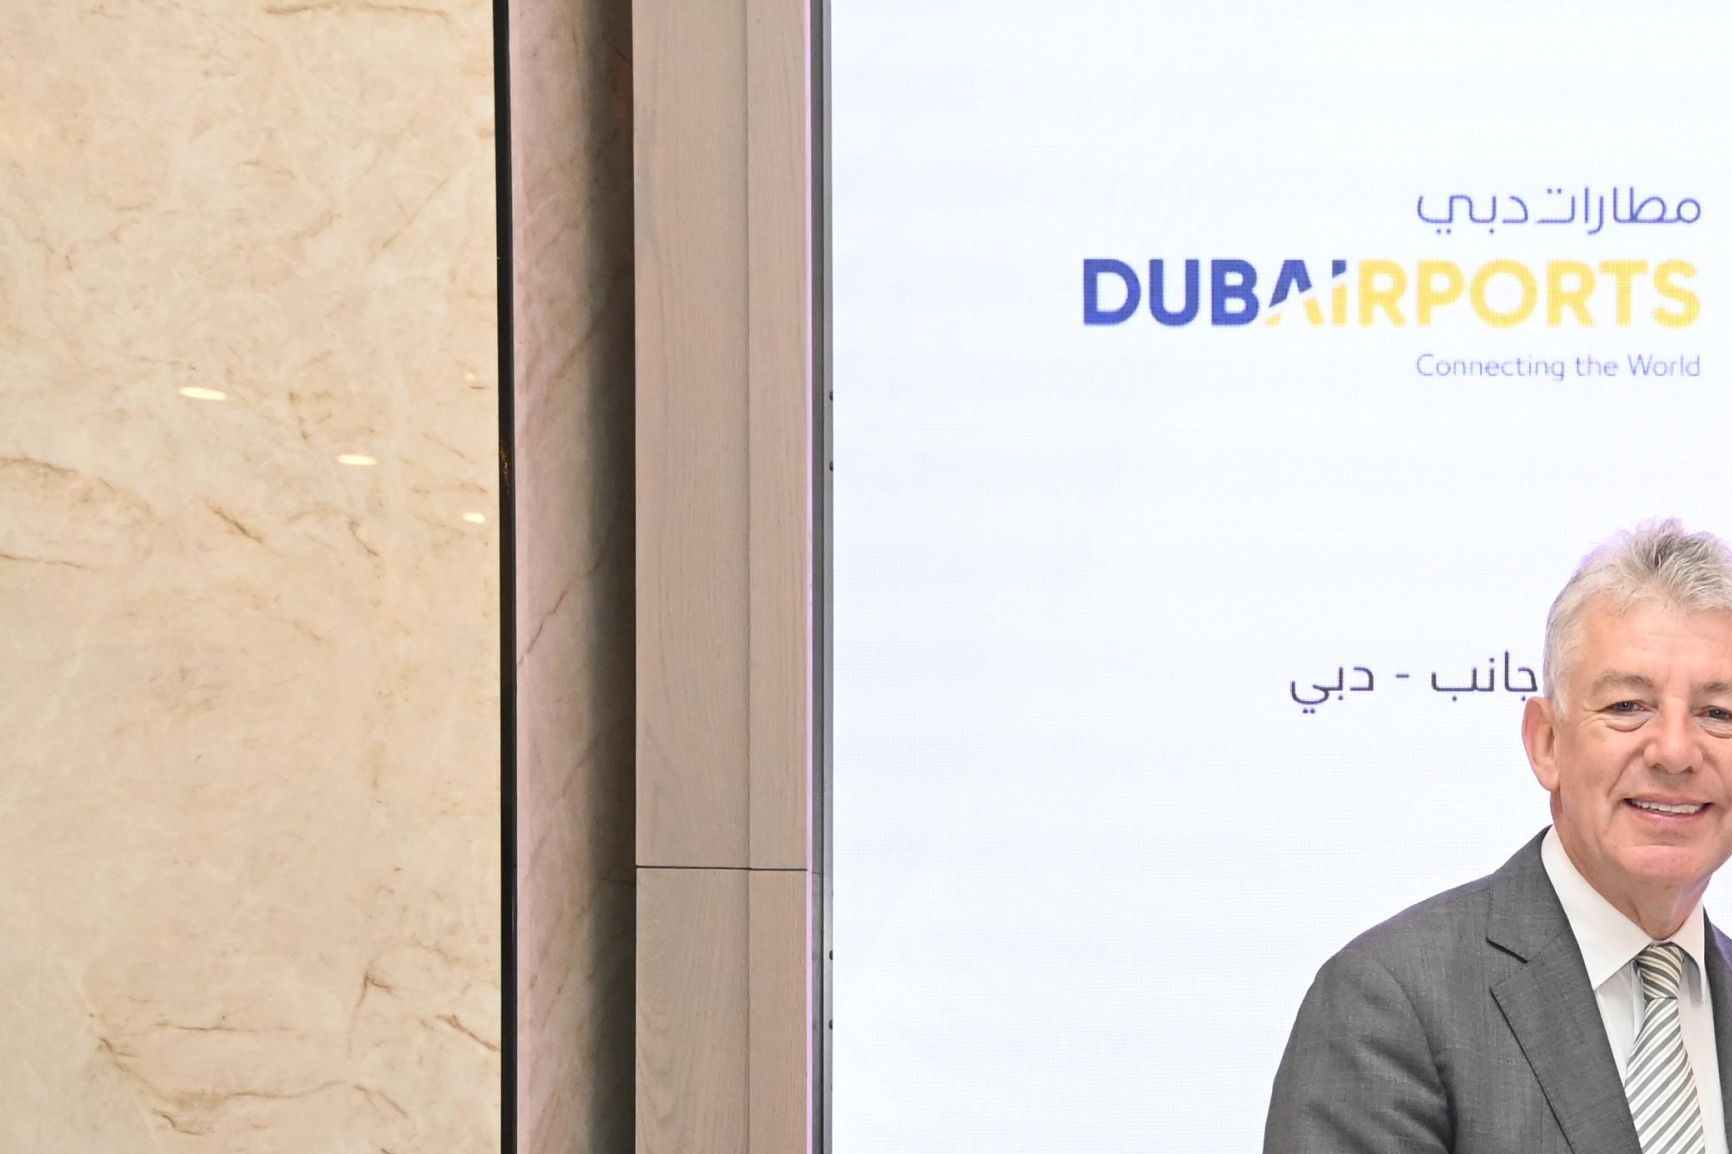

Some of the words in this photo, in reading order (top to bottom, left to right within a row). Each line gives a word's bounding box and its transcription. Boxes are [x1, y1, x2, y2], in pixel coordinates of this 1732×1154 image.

[1417, 193, 1529, 234] دبي
[1535, 187, 1701, 234] مطارات
[1416, 354, 1566, 381] Connecting
[1576, 354, 1618, 376] the
[1627, 354, 1700, 376] World
[1290, 666, 1374, 714] دبي
[1430, 650, 1538, 702] جانب
